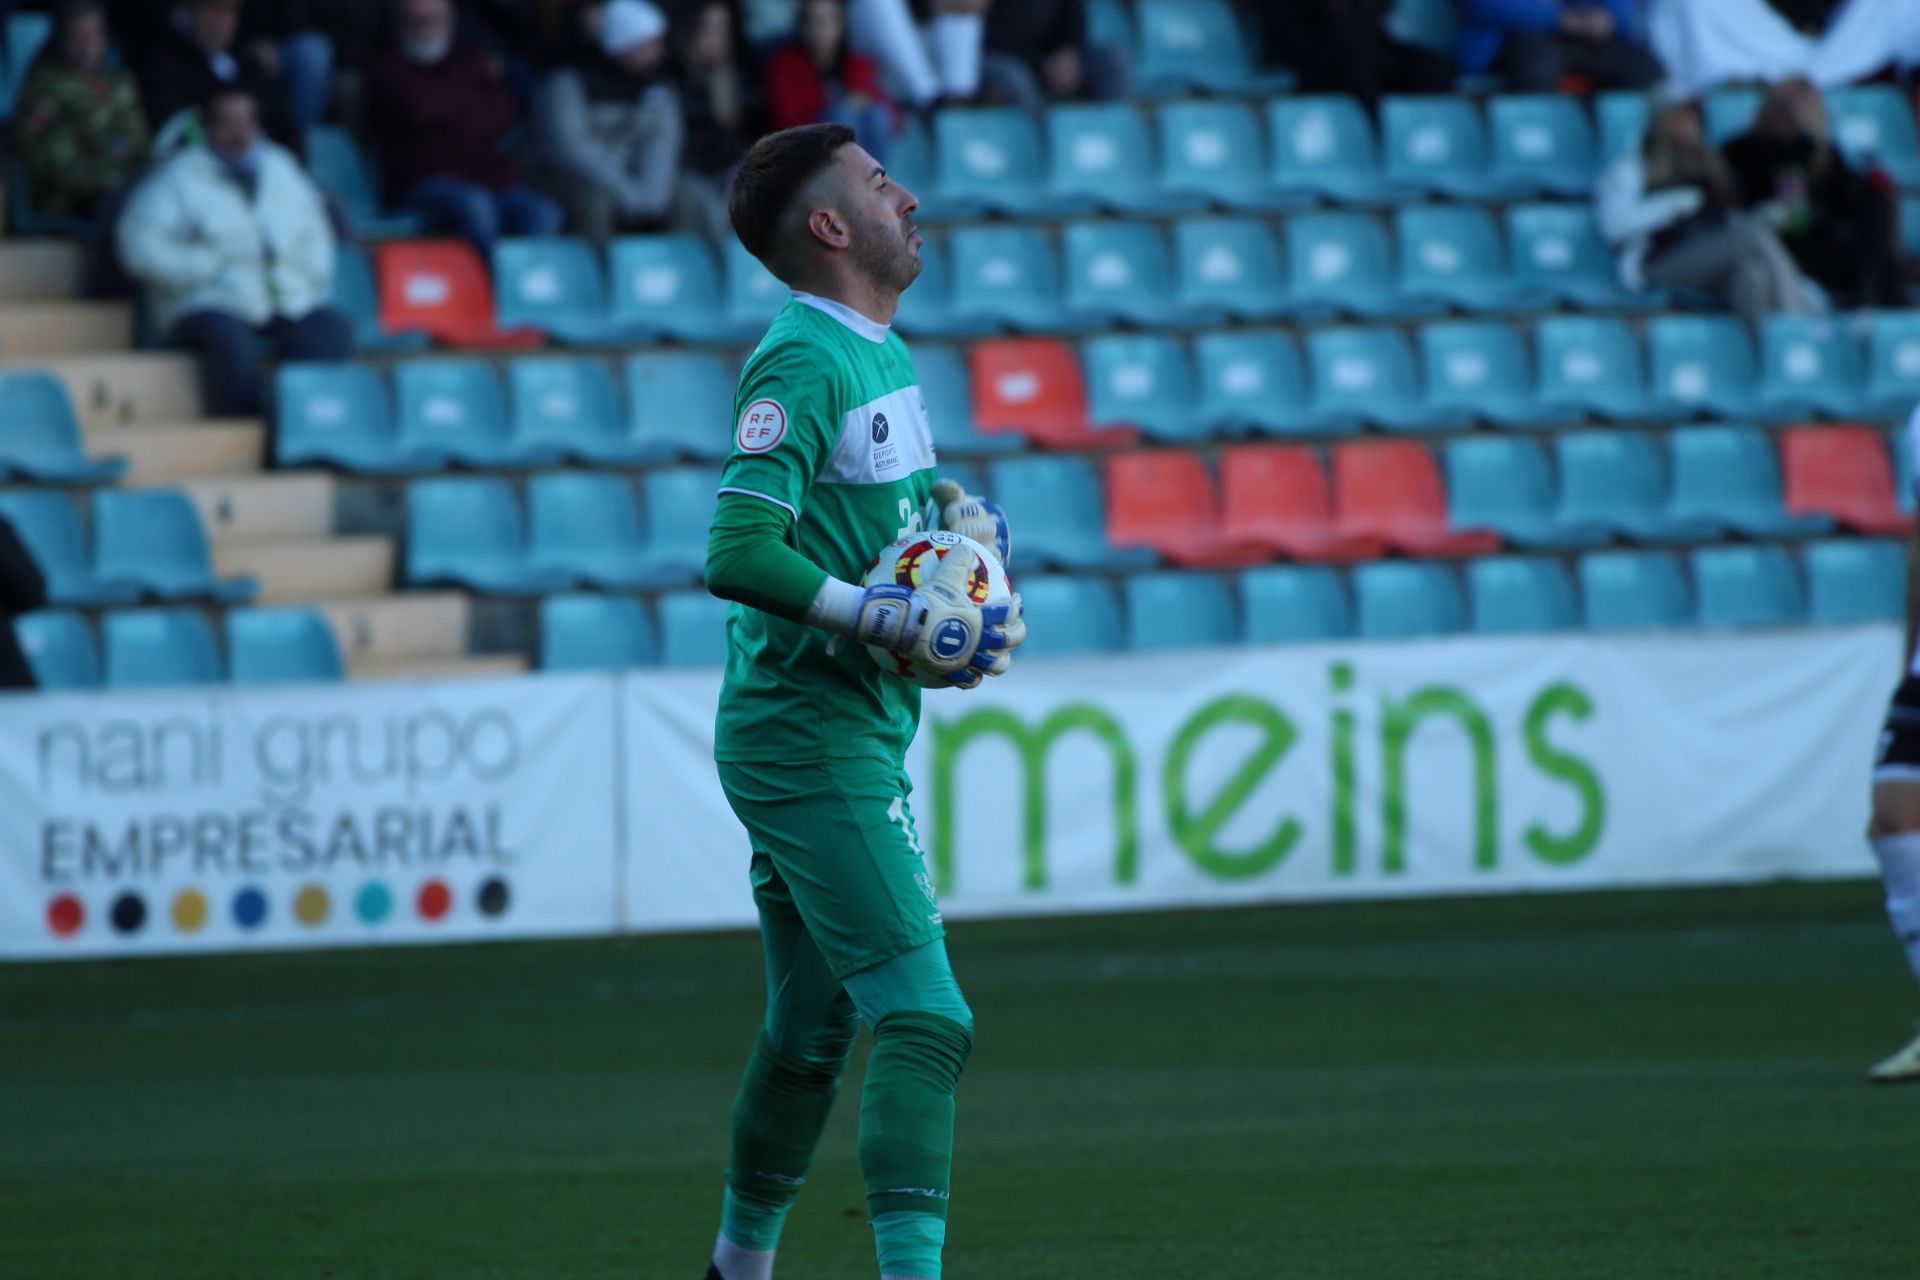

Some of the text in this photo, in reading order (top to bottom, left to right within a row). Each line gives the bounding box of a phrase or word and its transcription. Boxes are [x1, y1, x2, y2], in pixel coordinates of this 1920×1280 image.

[37, 706, 521, 806] nani grupo
[930, 661, 1607, 894] meins
[40, 804, 516, 882] EMPRESARIAL
